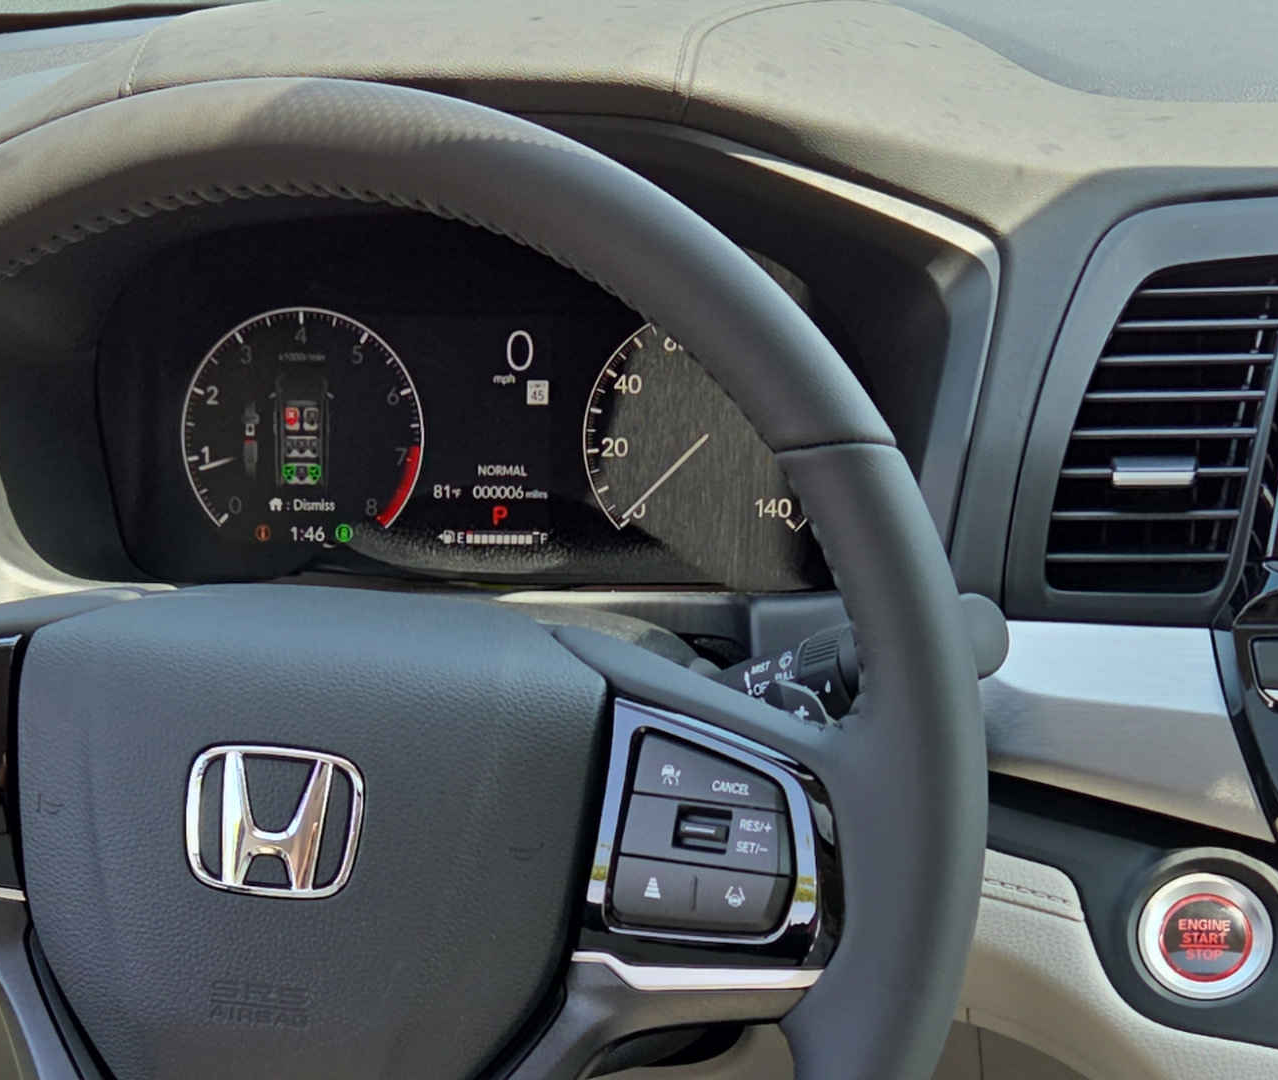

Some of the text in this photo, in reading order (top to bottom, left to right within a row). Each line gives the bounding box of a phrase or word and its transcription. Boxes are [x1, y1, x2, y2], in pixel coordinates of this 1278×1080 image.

[294, 328, 307, 345] 4
[240, 347, 252, 364] 3
[352, 347, 364, 364] 5
[506, 330, 534, 372] 0
[493, 375, 516, 386] mph
[614, 375, 642, 395] 40
[206, 387, 219, 405] 2
[387, 389, 400, 405] 6
[531, 390, 545, 401] 45
[201, 447, 210, 464] 1
[601, 437, 628, 458] 20
[395, 449, 407, 466] 7
[477, 465, 528, 477] NORMAL
[472, 485, 548, 499] 000006 miles
[228, 497, 242, 513] 0
[293, 499, 335, 513] Dismiss
[365, 499, 378, 516] 8
[755, 499, 792, 518] 140
[492, 505, 508, 525] P
[290, 527, 325, 542] 1:46
[457, 532, 465, 544] E
[540, 533, 549, 545] F
[712, 780, 750, 797] CANCEL
[1178, 918, 1231, 931] ENGINE
[1182, 932, 1227, 944] START
[1186, 948, 1224, 960] STOP
